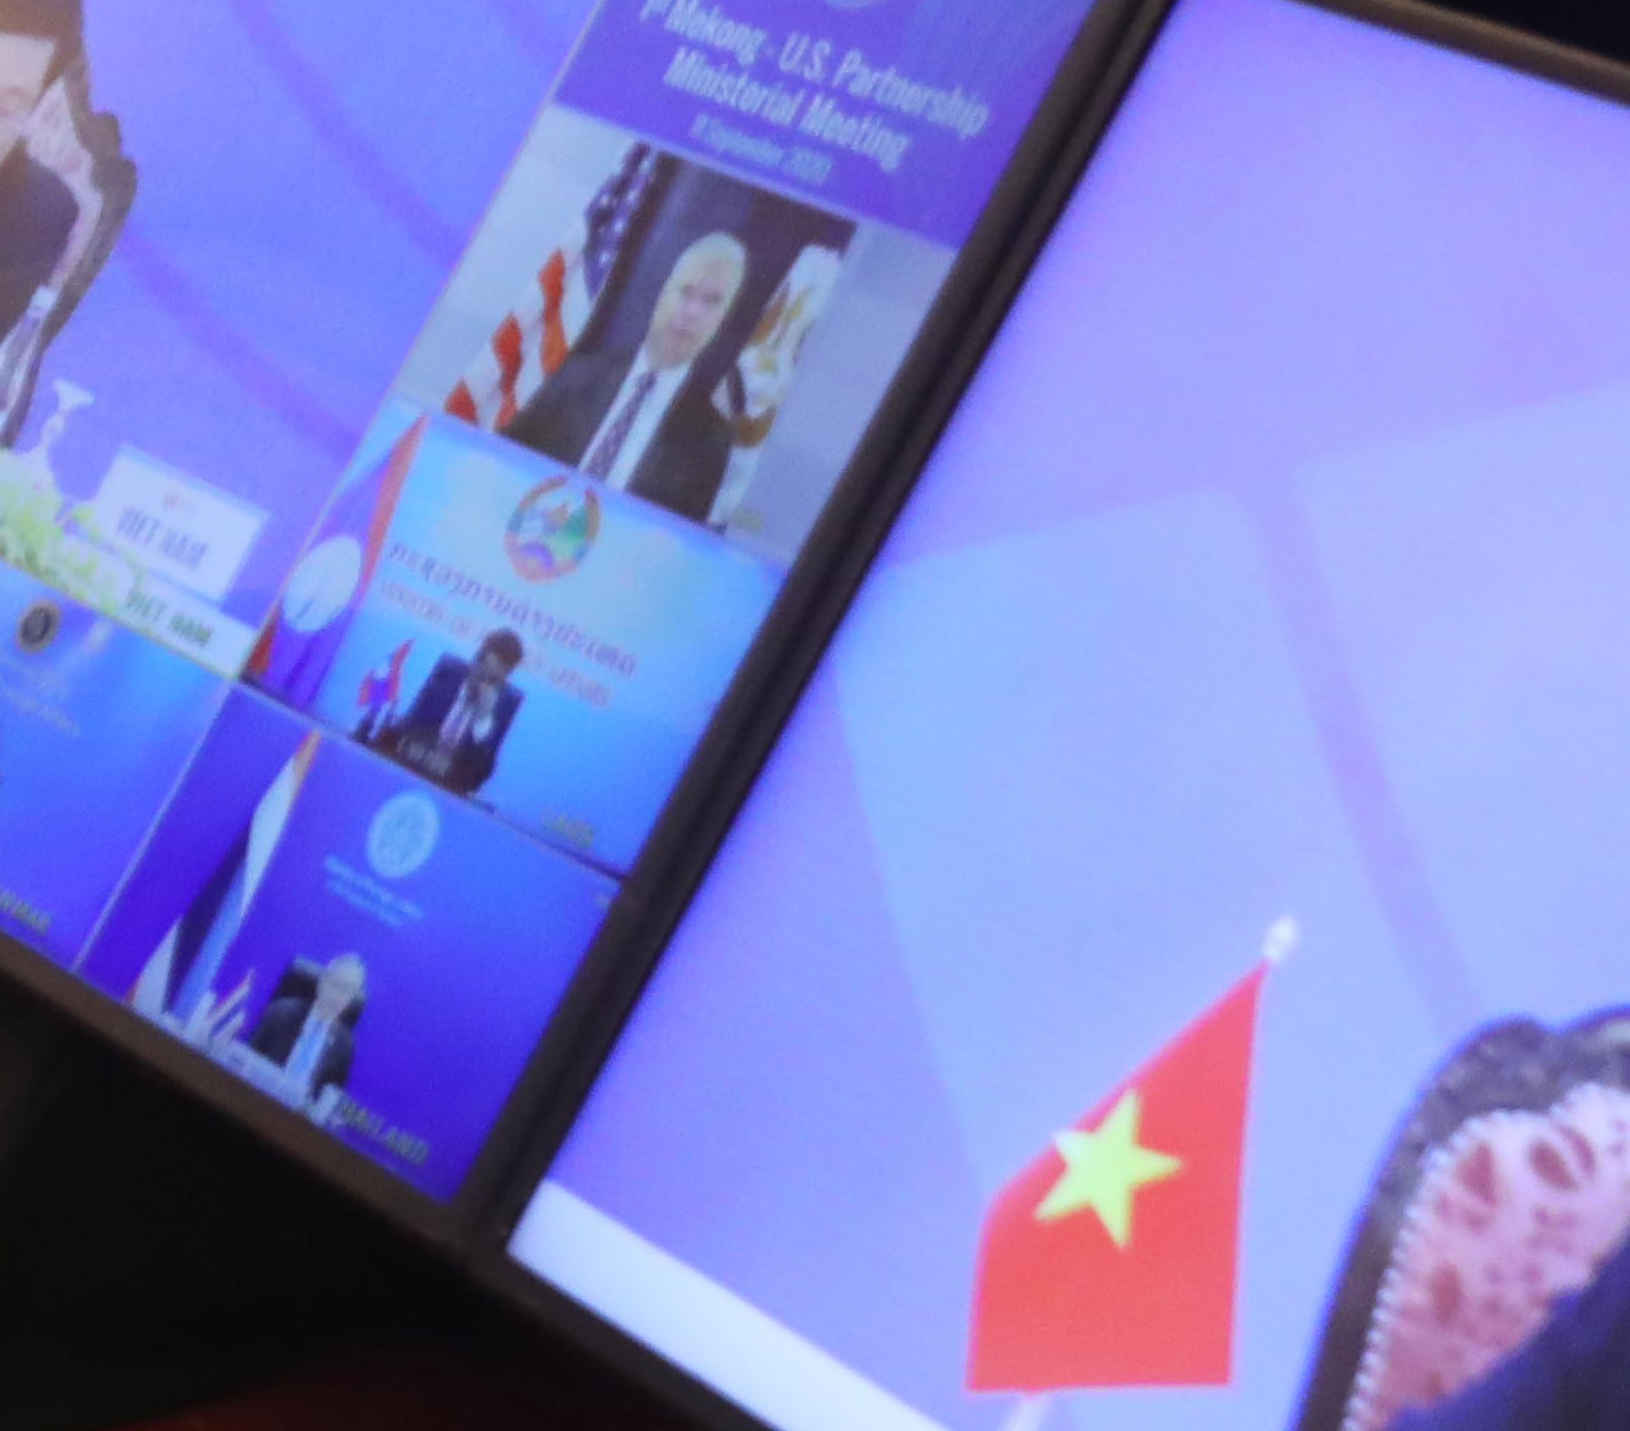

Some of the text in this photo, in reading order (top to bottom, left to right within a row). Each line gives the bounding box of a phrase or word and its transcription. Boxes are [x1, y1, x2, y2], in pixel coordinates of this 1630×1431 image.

[663, 45, 913, 174] Ministerial Meeting
[832, 48, 990, 142] Partnership
